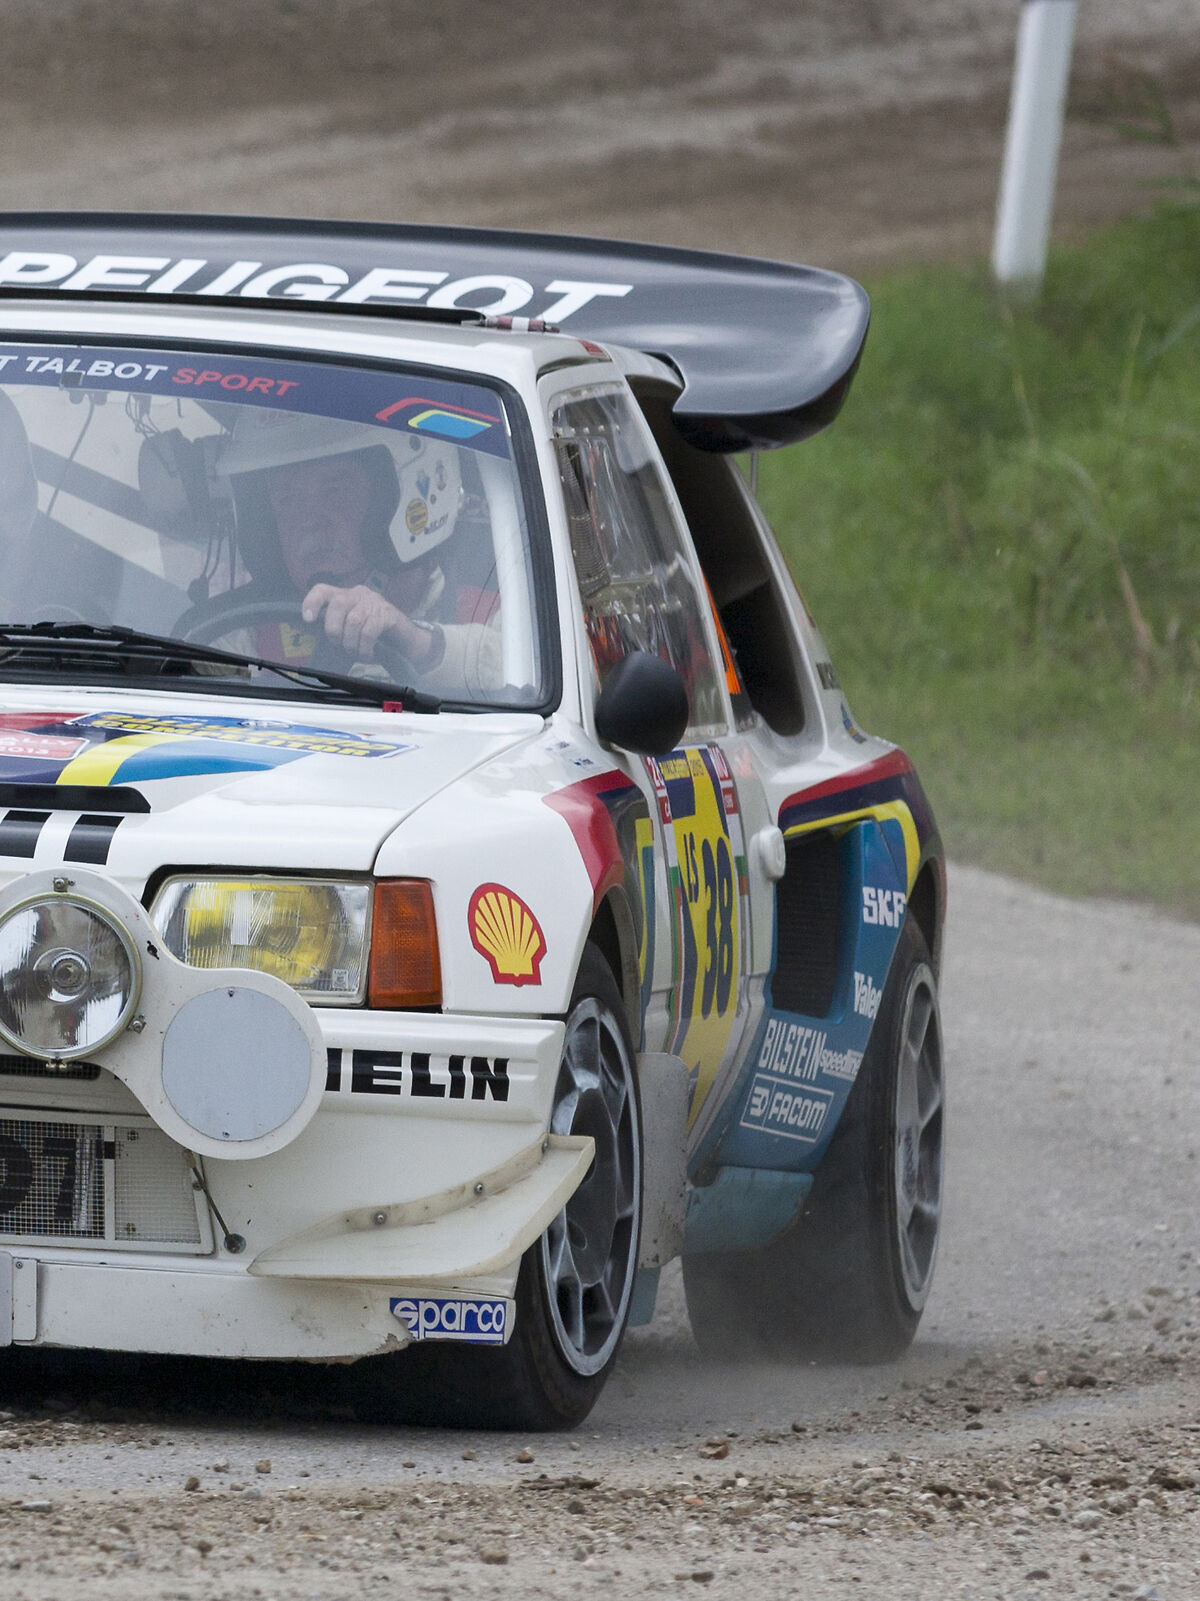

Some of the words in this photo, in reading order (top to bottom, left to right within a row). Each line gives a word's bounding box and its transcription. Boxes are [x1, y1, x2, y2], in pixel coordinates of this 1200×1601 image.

[23, 356, 168, 382] TALBOT
[172, 368, 298, 397] SPORT
[862, 886, 907, 928] SKF
[701, 837, 733, 1020] 38
[758, 1019, 827, 1081] BILSTEIN
[767, 1091, 827, 1131] FACOM
[394, 1299, 505, 1342] sparco
